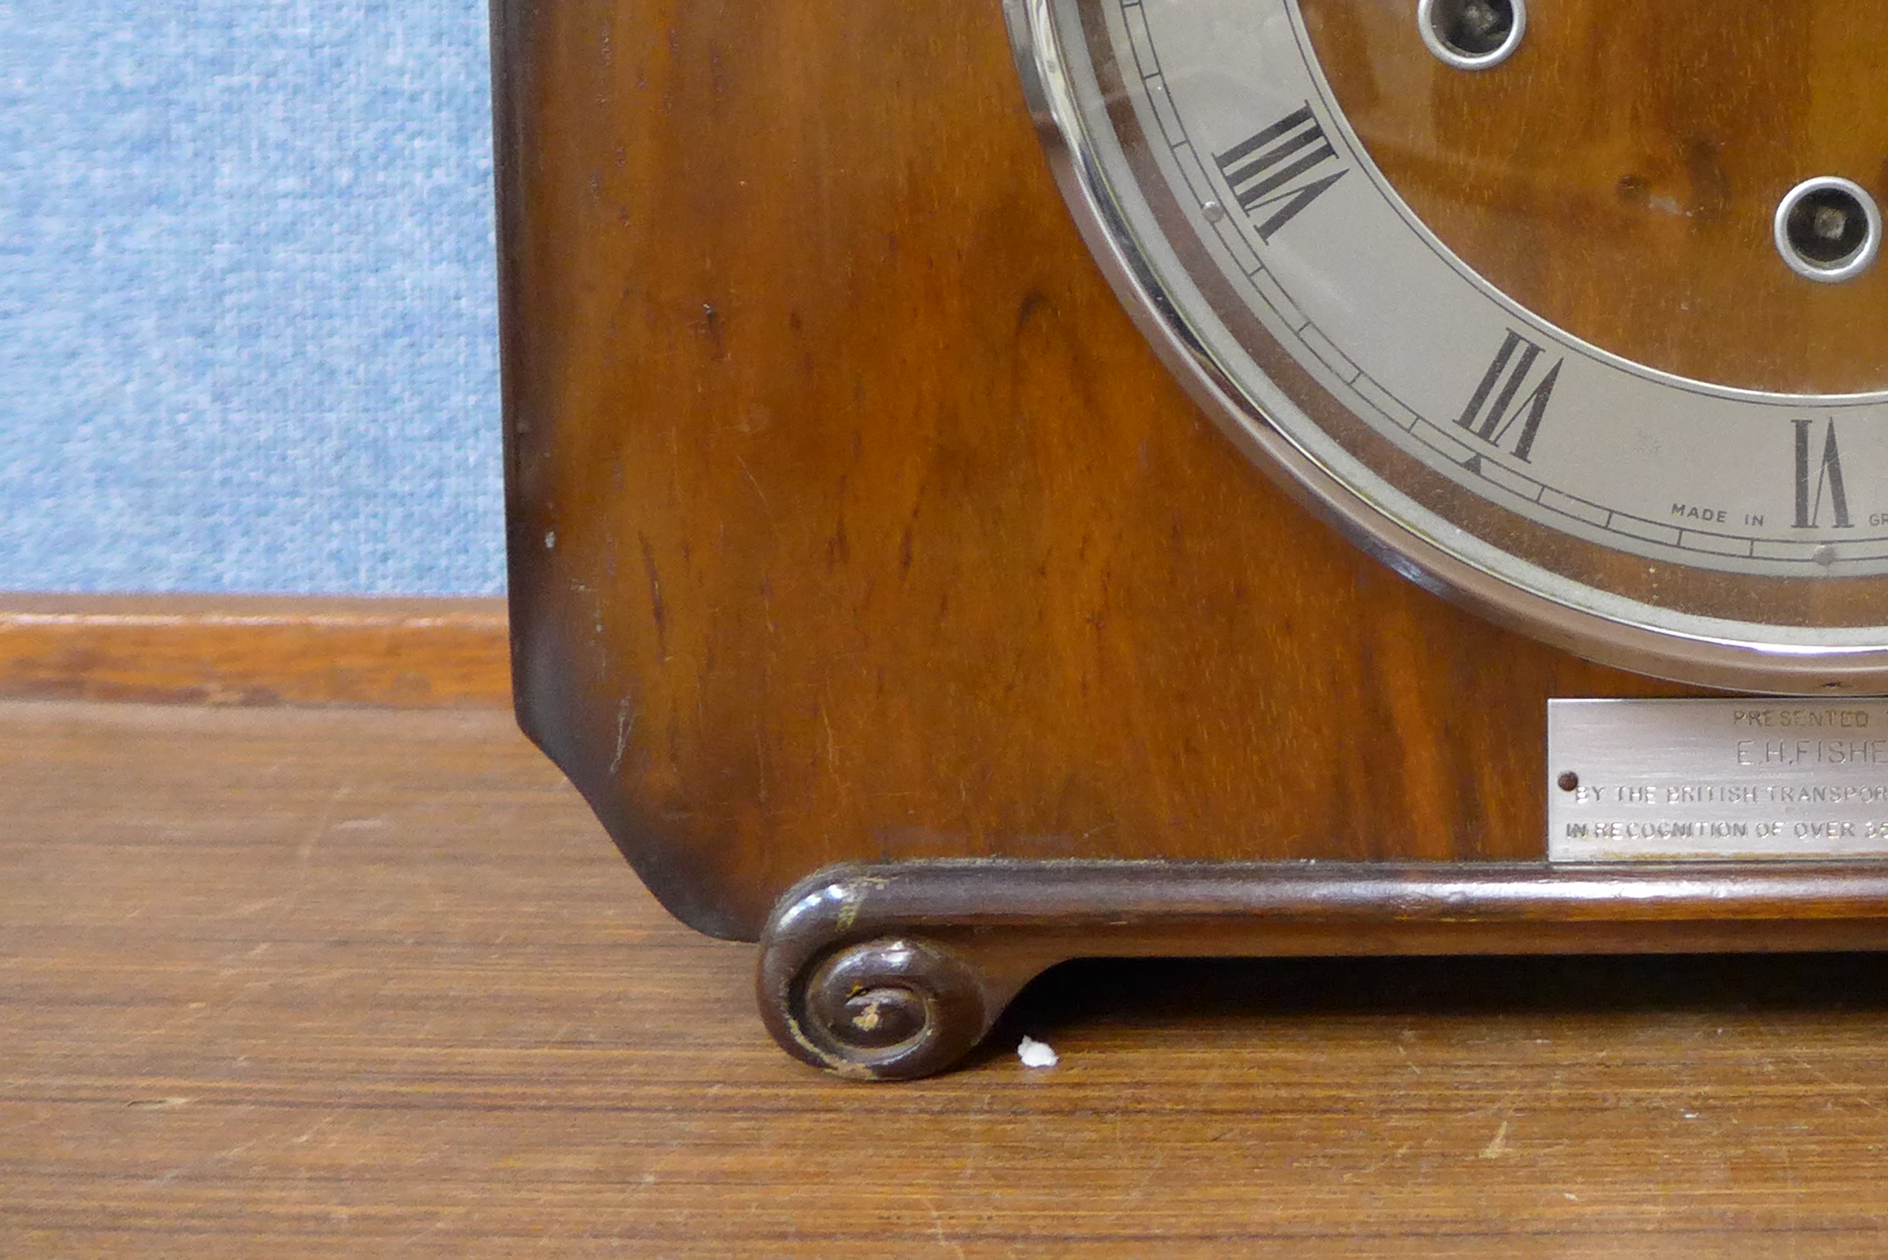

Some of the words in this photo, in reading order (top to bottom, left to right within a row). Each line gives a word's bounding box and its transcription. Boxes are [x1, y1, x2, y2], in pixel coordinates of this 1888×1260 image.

[1211, 99, 1350, 246] VIII
[1452, 327, 1564, 465] VII
[1790, 416, 1855, 528] VI
[1671, 502, 1727, 524] MADE
[1744, 513, 1765, 527] IN
[1733, 710, 1868, 728] PRESENTED
[1575, 786, 1605, 804] BY
[1616, 786, 1657, 804] THE
[1666, 786, 1756, 804] BRITISH
[1566, 822, 1588, 839] IN
[1594, 821, 1748, 840] RECOGNITION
[1755, 821, 1785, 839] OF
[1794, 821, 1855, 839] OVER
